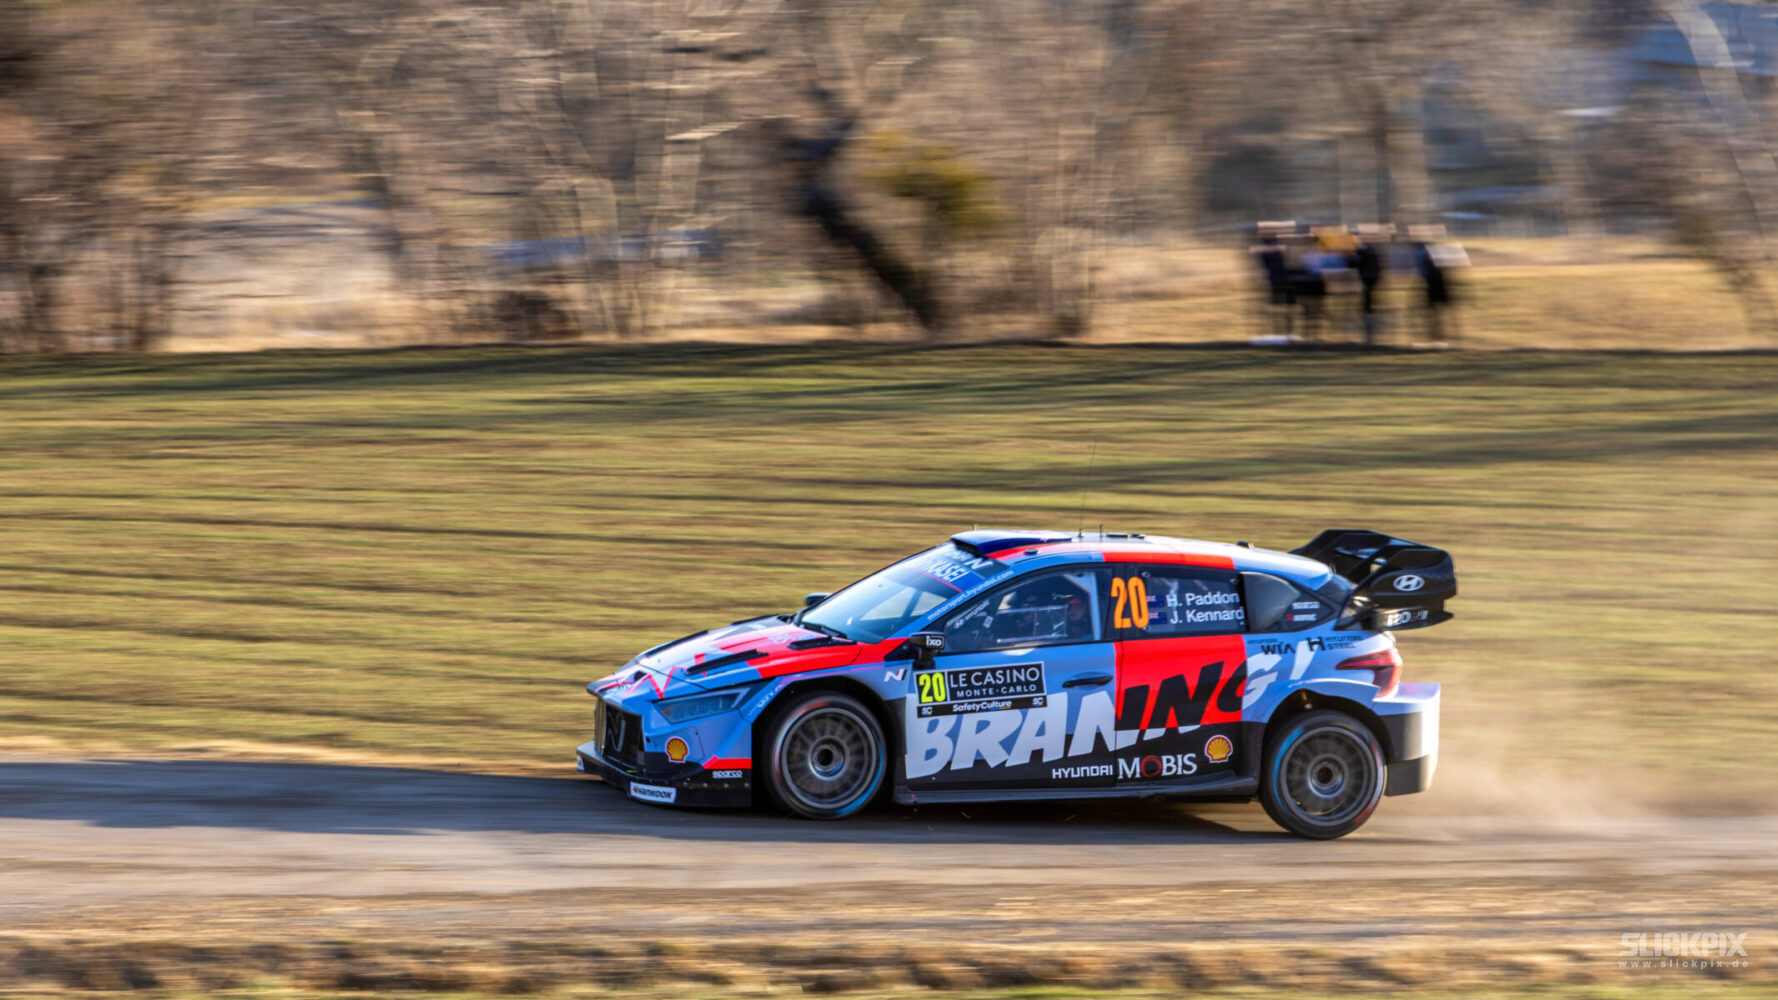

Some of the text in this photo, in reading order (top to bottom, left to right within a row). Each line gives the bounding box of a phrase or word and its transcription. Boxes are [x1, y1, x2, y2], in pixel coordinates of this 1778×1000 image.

[1110, 576, 1149, 629] 20
[1166, 591, 1240, 607] H. Paddon
[1170, 606, 1245, 624] J. Kennard
[918, 672, 947, 703] 20
[950, 667, 1040, 689] LE CASINO
[953, 700, 1012, 712] SafetyCulture
[1052, 764, 1113, 779] HYUNDAI
[1117, 753, 1198, 780] MOBIS
